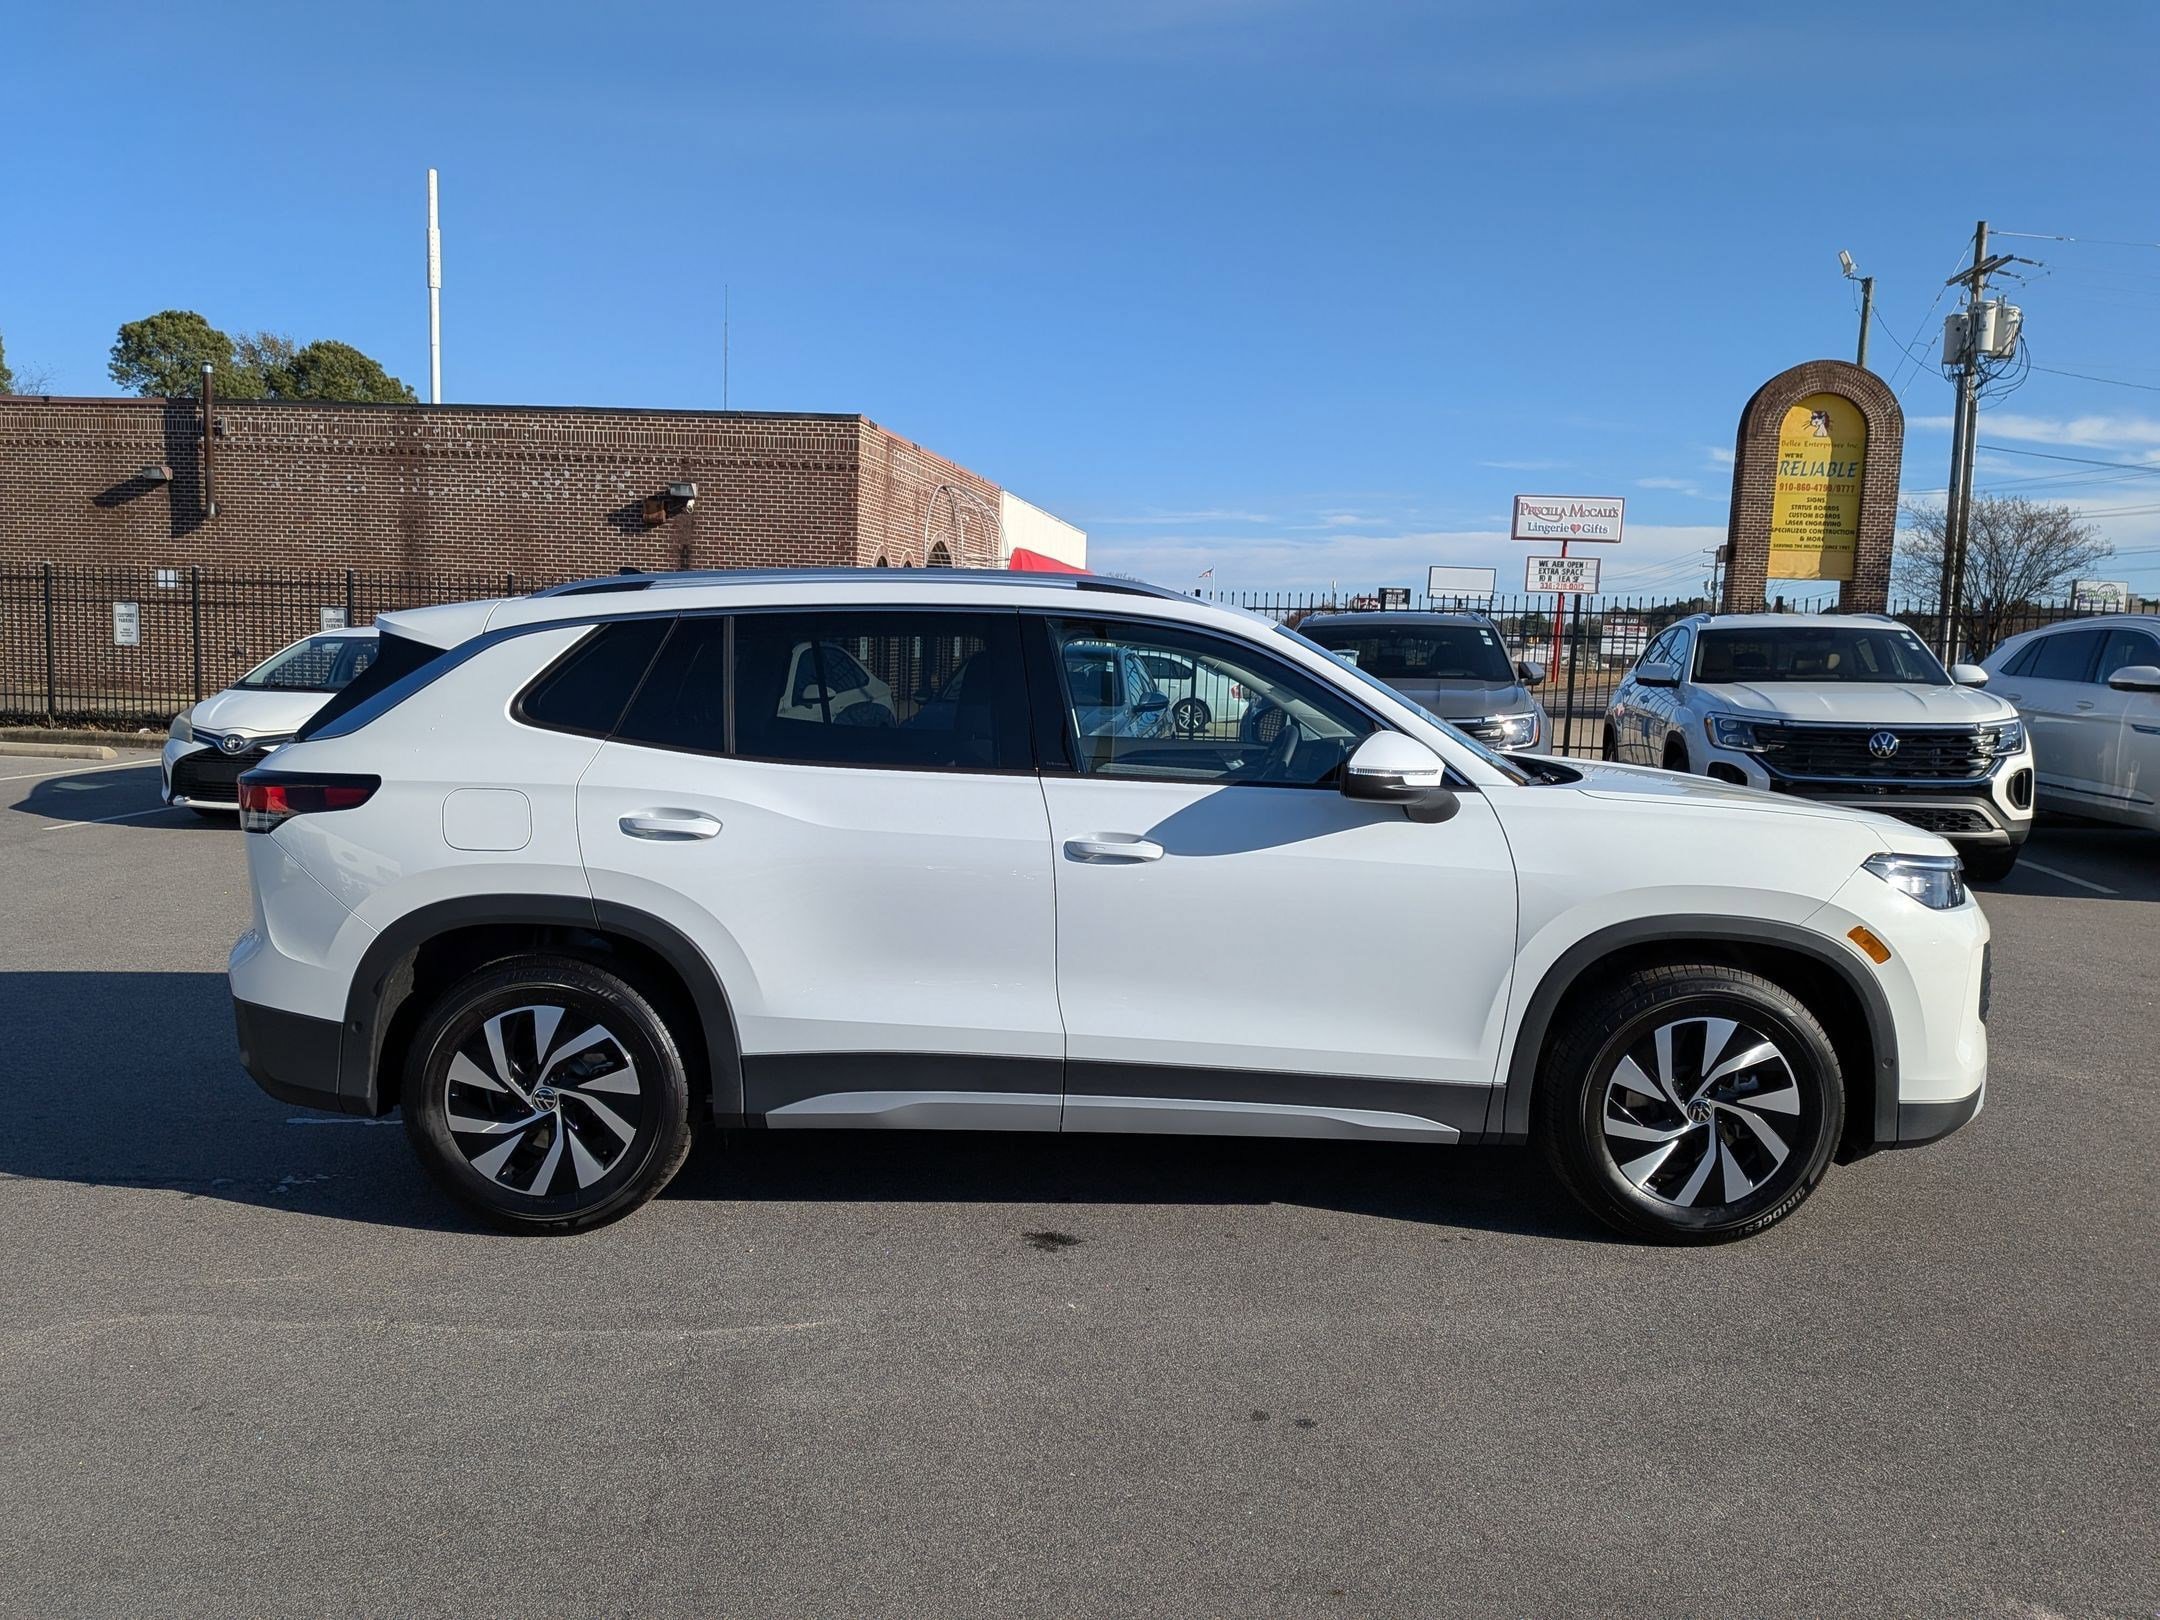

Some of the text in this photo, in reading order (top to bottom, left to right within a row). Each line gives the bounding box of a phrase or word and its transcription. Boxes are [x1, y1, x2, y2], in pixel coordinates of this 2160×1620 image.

[1778, 460, 1859, 478] RELIABLE
[1527, 521, 1609, 535] Lingerie Gifts
[1785, 519, 1842, 528] LASER ENGRAVING
[1808, 528, 1855, 536] CONSTRUCTION
[1538, 567, 1584, 577] EXTRA SPACE
[1713, 1186, 1806, 1236] BRIDGESTON
